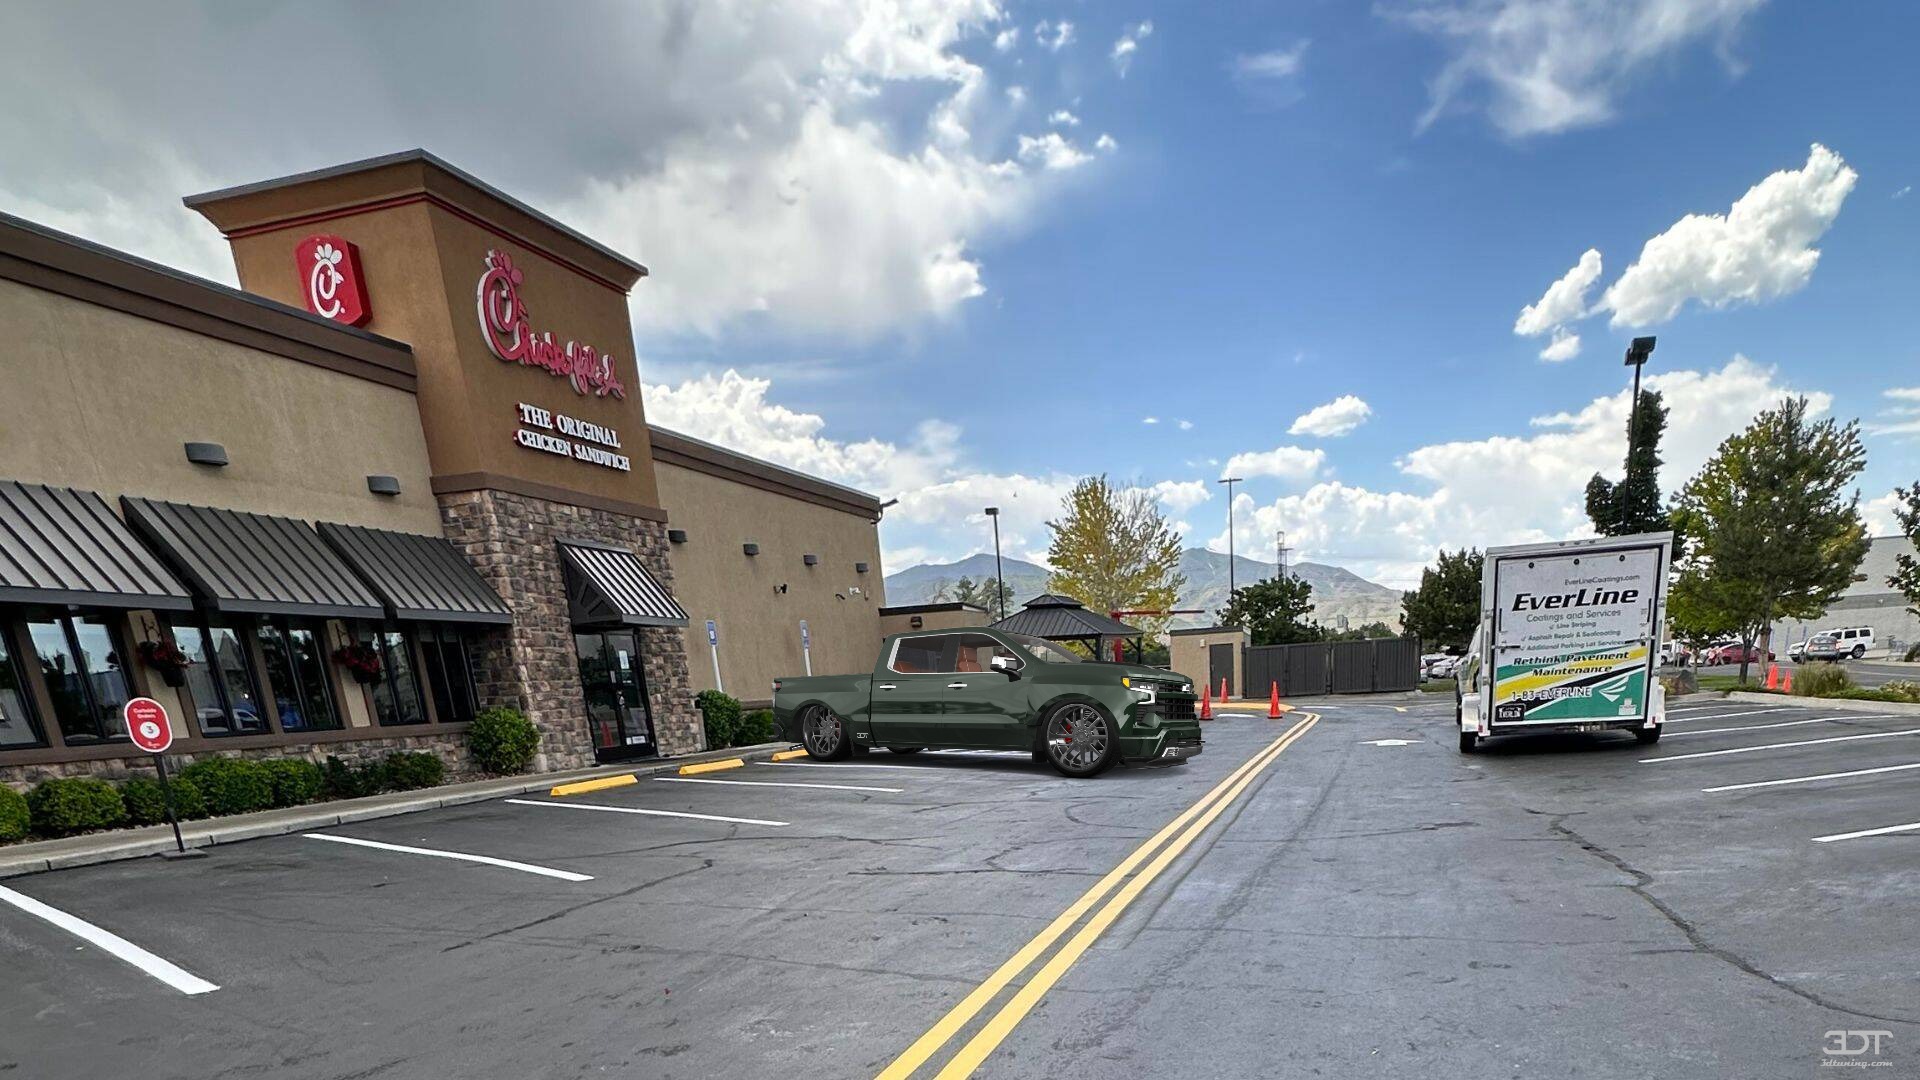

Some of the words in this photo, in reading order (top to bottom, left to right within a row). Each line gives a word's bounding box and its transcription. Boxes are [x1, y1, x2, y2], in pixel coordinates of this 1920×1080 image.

[517, 402, 553, 430] THE
[555, 413, 621, 450] ORIGINAL
[516, 428, 573, 457] CHICKEN
[574, 443, 631, 472] SANDWICH
[1564, 574, 1641, 586] EverLineCoatings.com
[1511, 587, 1640, 612] EverLine
[1526, 612, 1564, 624] Coatings
[1565, 610, 1584, 620] and
[1586, 609, 1622, 619] Services
[1528, 633, 1552, 641] Asphalt
[1554, 632, 1575, 640] Repair
[1526, 643, 1559, 651] Additional
[1560, 641, 1585, 650] Parking
[1513, 656, 1562, 666] Rethink
[1565, 651, 1630, 663] Pavement
[1532, 665, 1613, 677] Maintenance
[145, 725, 154, 734] 3
